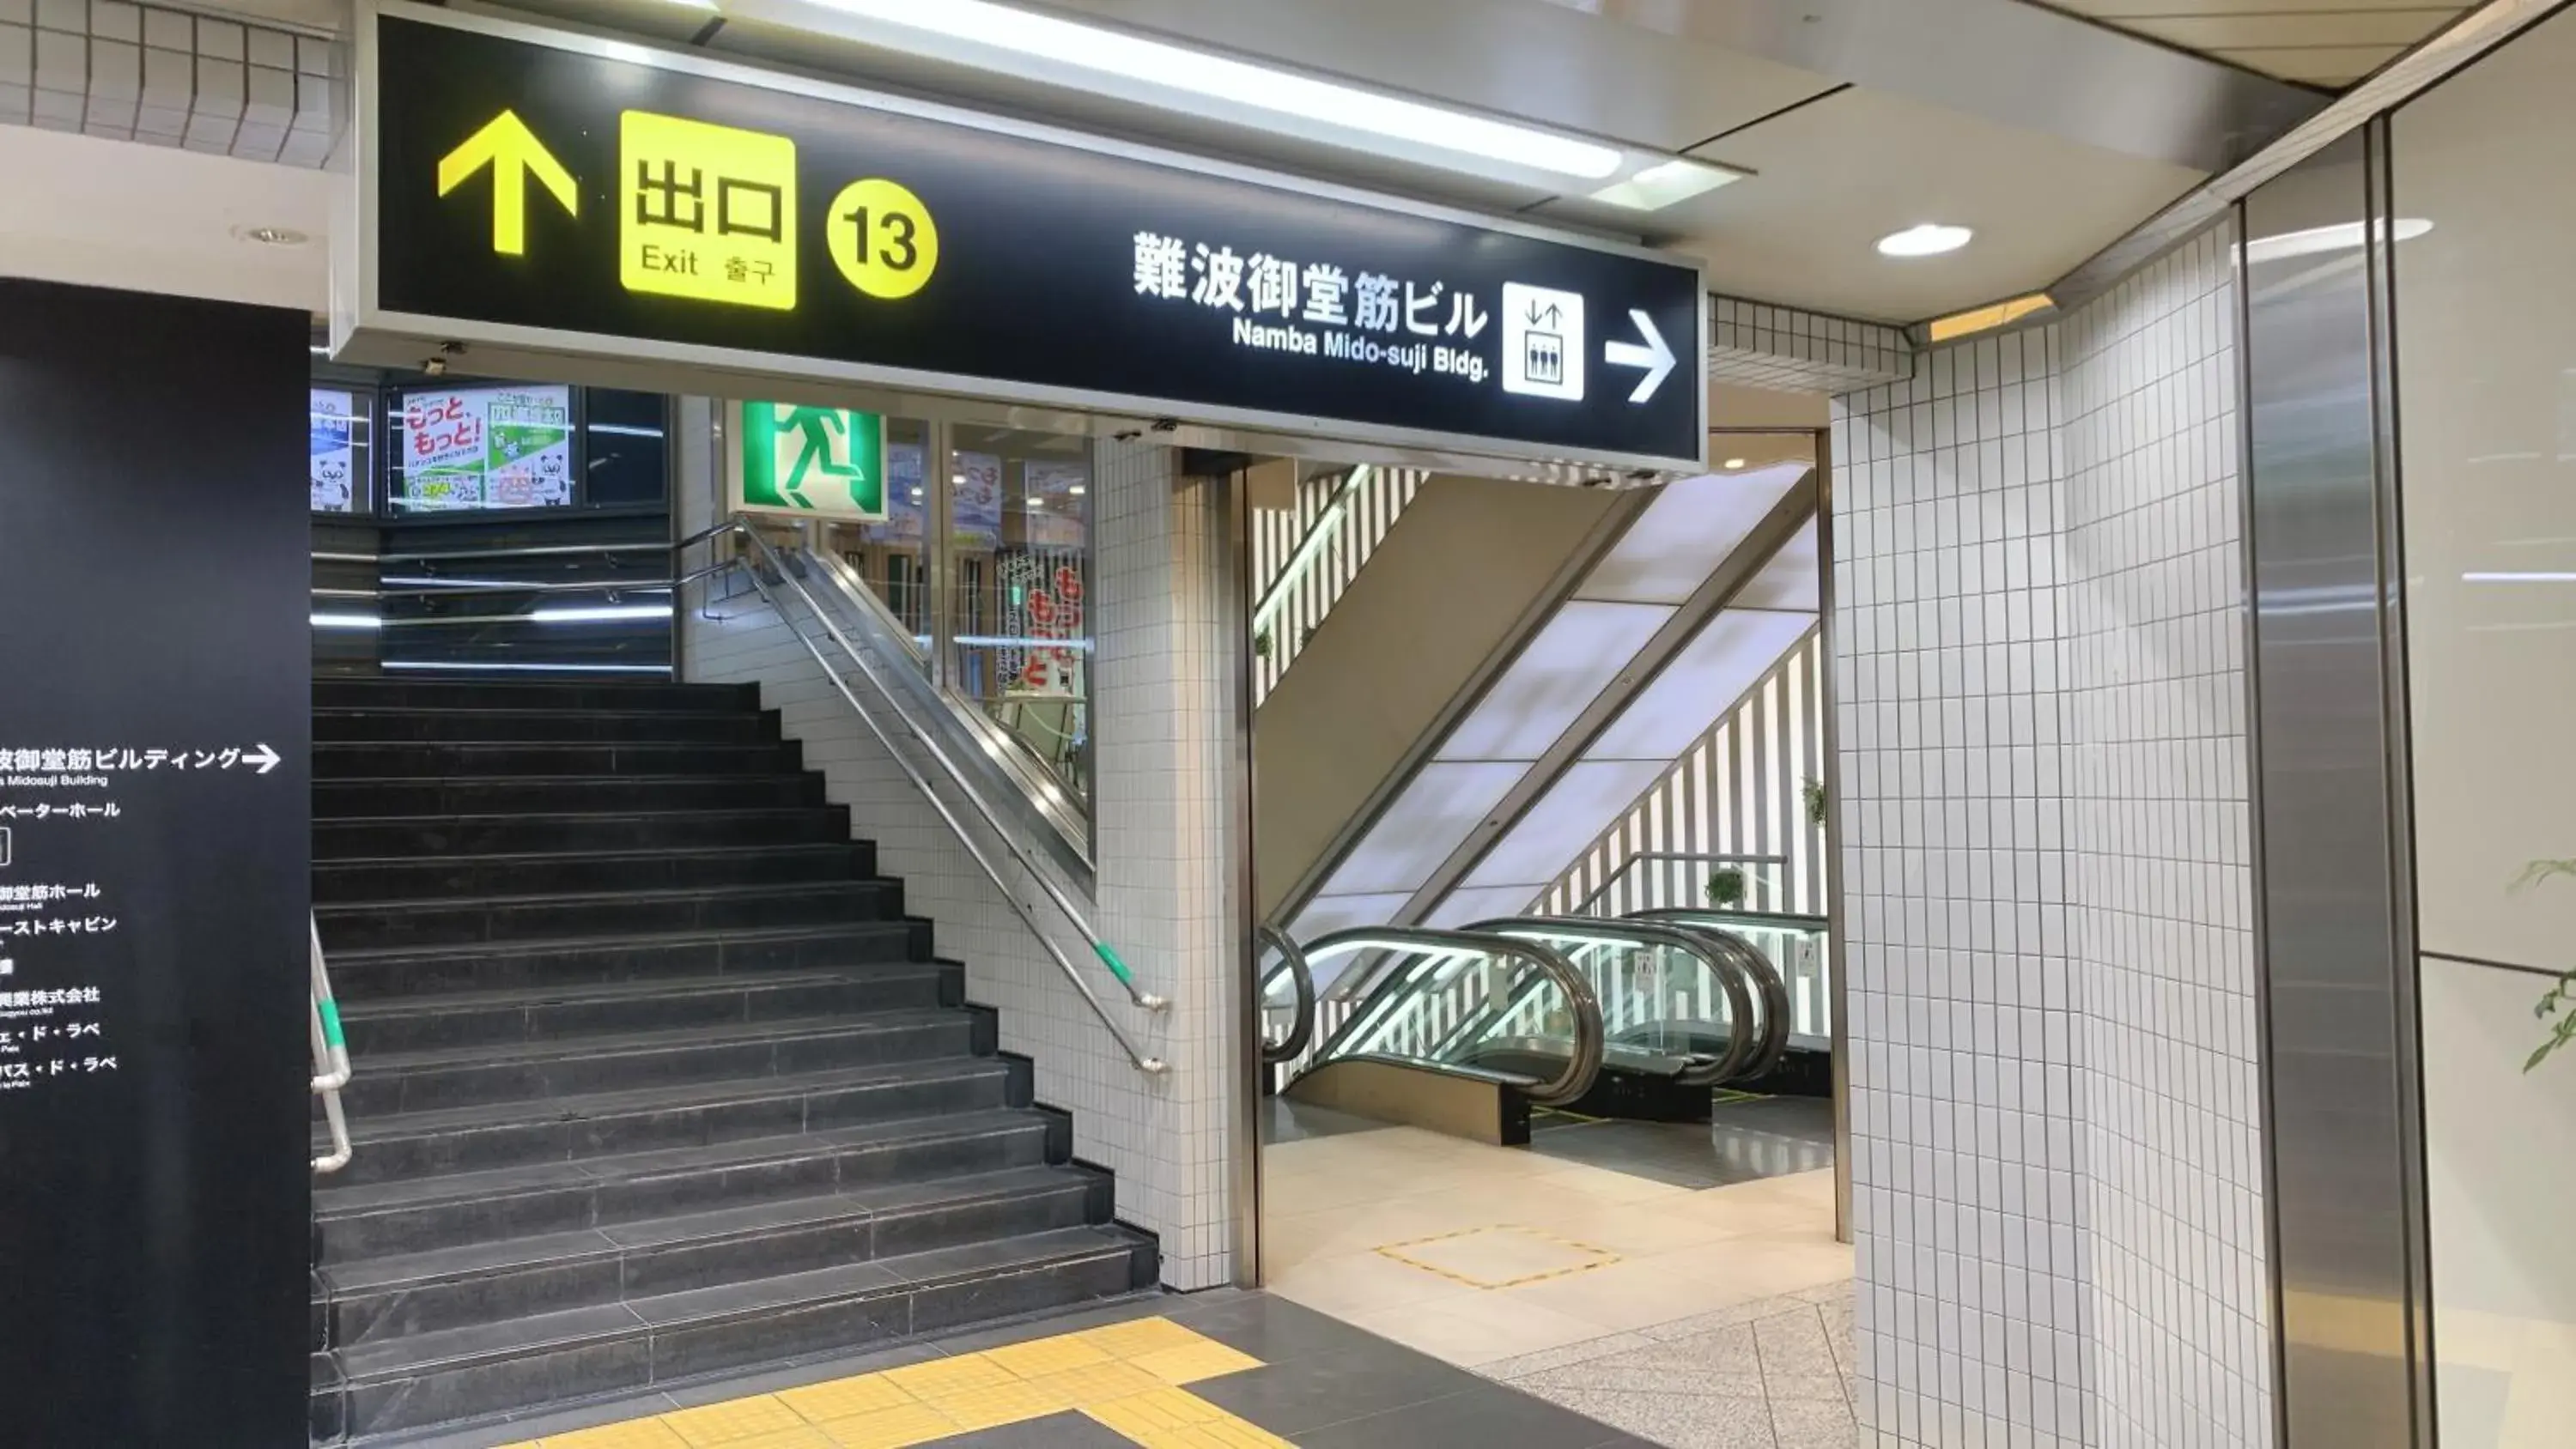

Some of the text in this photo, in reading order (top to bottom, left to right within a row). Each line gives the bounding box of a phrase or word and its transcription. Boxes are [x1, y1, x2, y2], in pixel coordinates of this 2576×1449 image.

[636, 159, 782, 244] 出口
[641, 244, 699, 276] Exit
[724, 256, 776, 286] 출구
[842, 205, 917, 272] 13
[1132, 231, 1488, 341] 難波御堂筋ビル
[1233, 317, 1489, 384] Namba Mido-suji Bldg.
